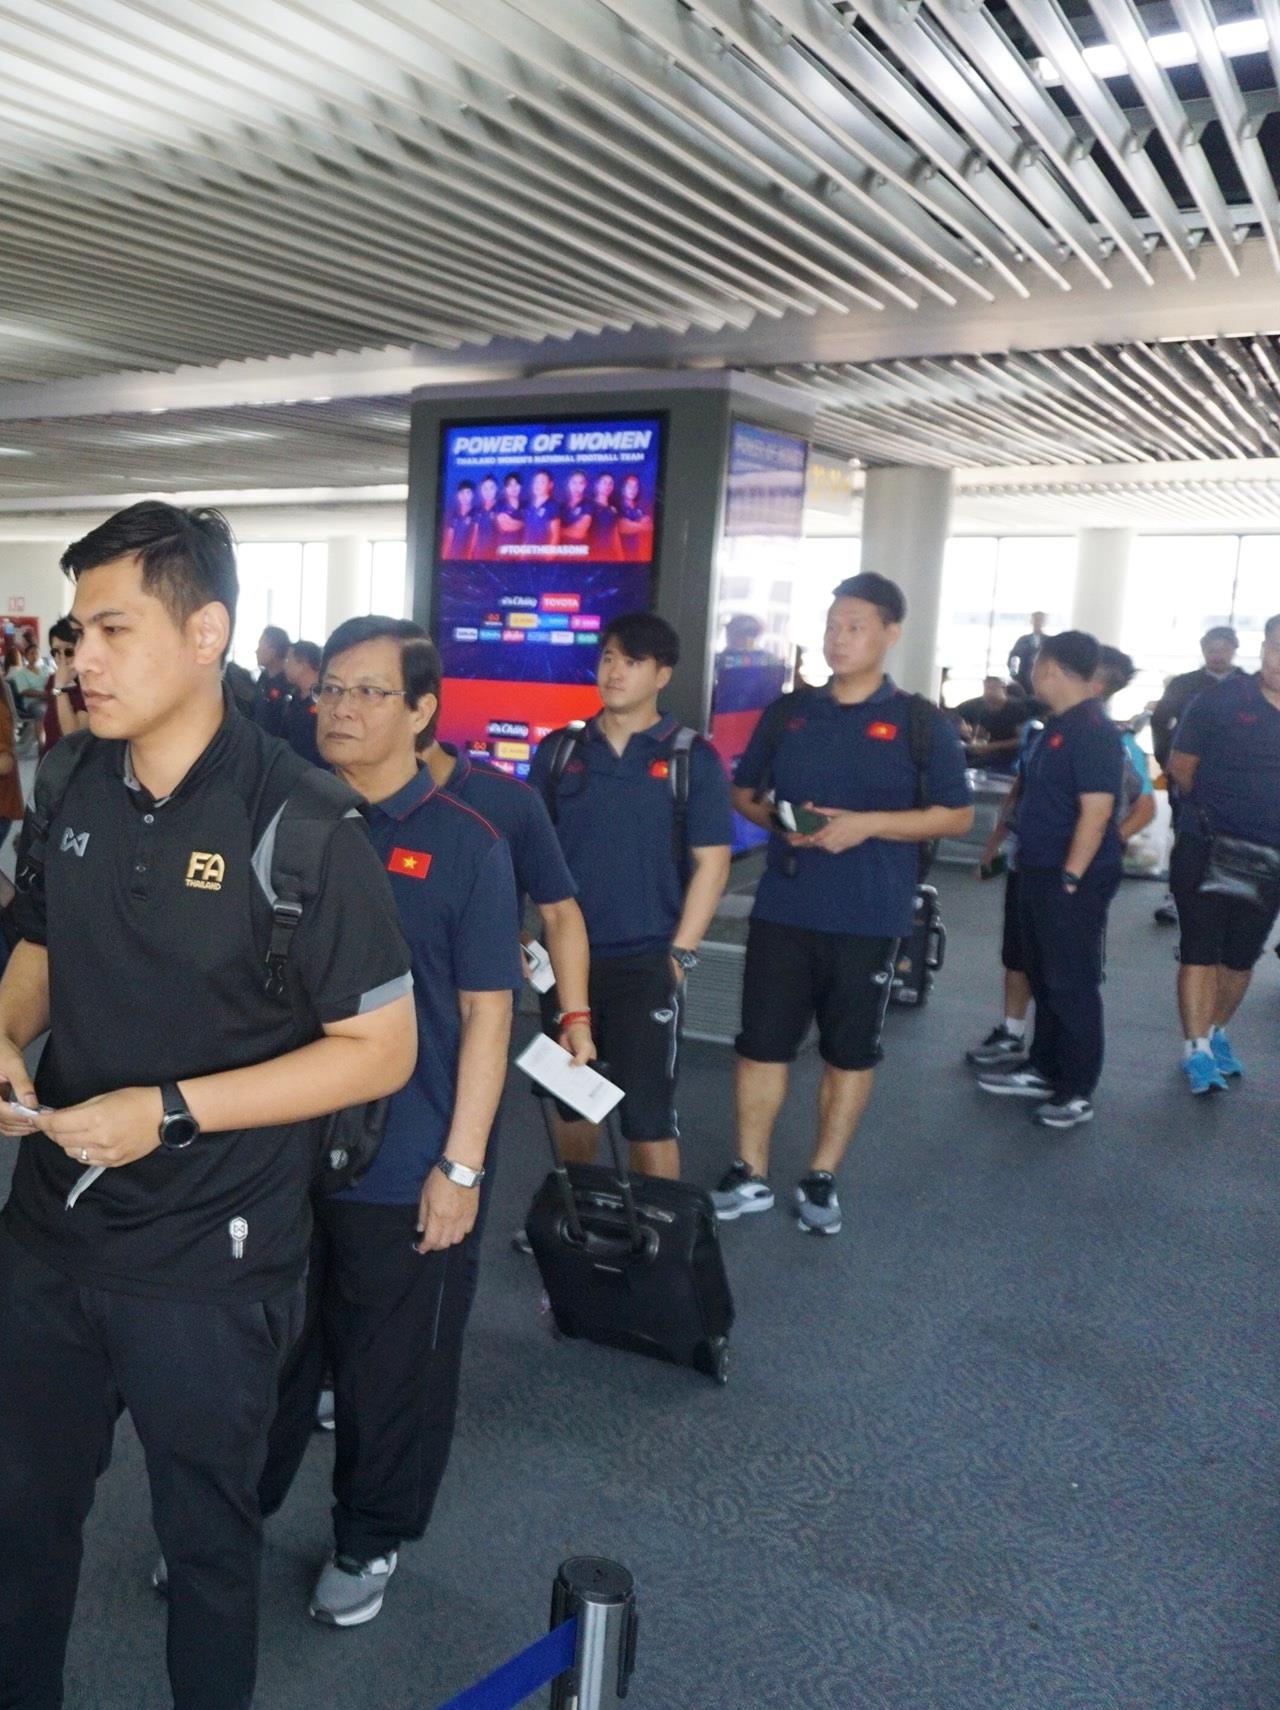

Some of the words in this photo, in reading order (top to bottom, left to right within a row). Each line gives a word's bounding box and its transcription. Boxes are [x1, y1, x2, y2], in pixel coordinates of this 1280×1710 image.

[454, 435, 527, 455] POWER
[532, 434, 564, 453] OF
[570, 430, 652, 450] WOMEN
[456, 456, 496, 466] THAILAND
[534, 454, 575, 464] NATIONAL
[577, 453, 618, 463] FOOTBALL
[621, 452, 644, 462] TEAM
[543, 597, 580, 607] TOYOTA
[186, 851, 226, 882] FA
[185, 878, 222, 891] THAILAND
